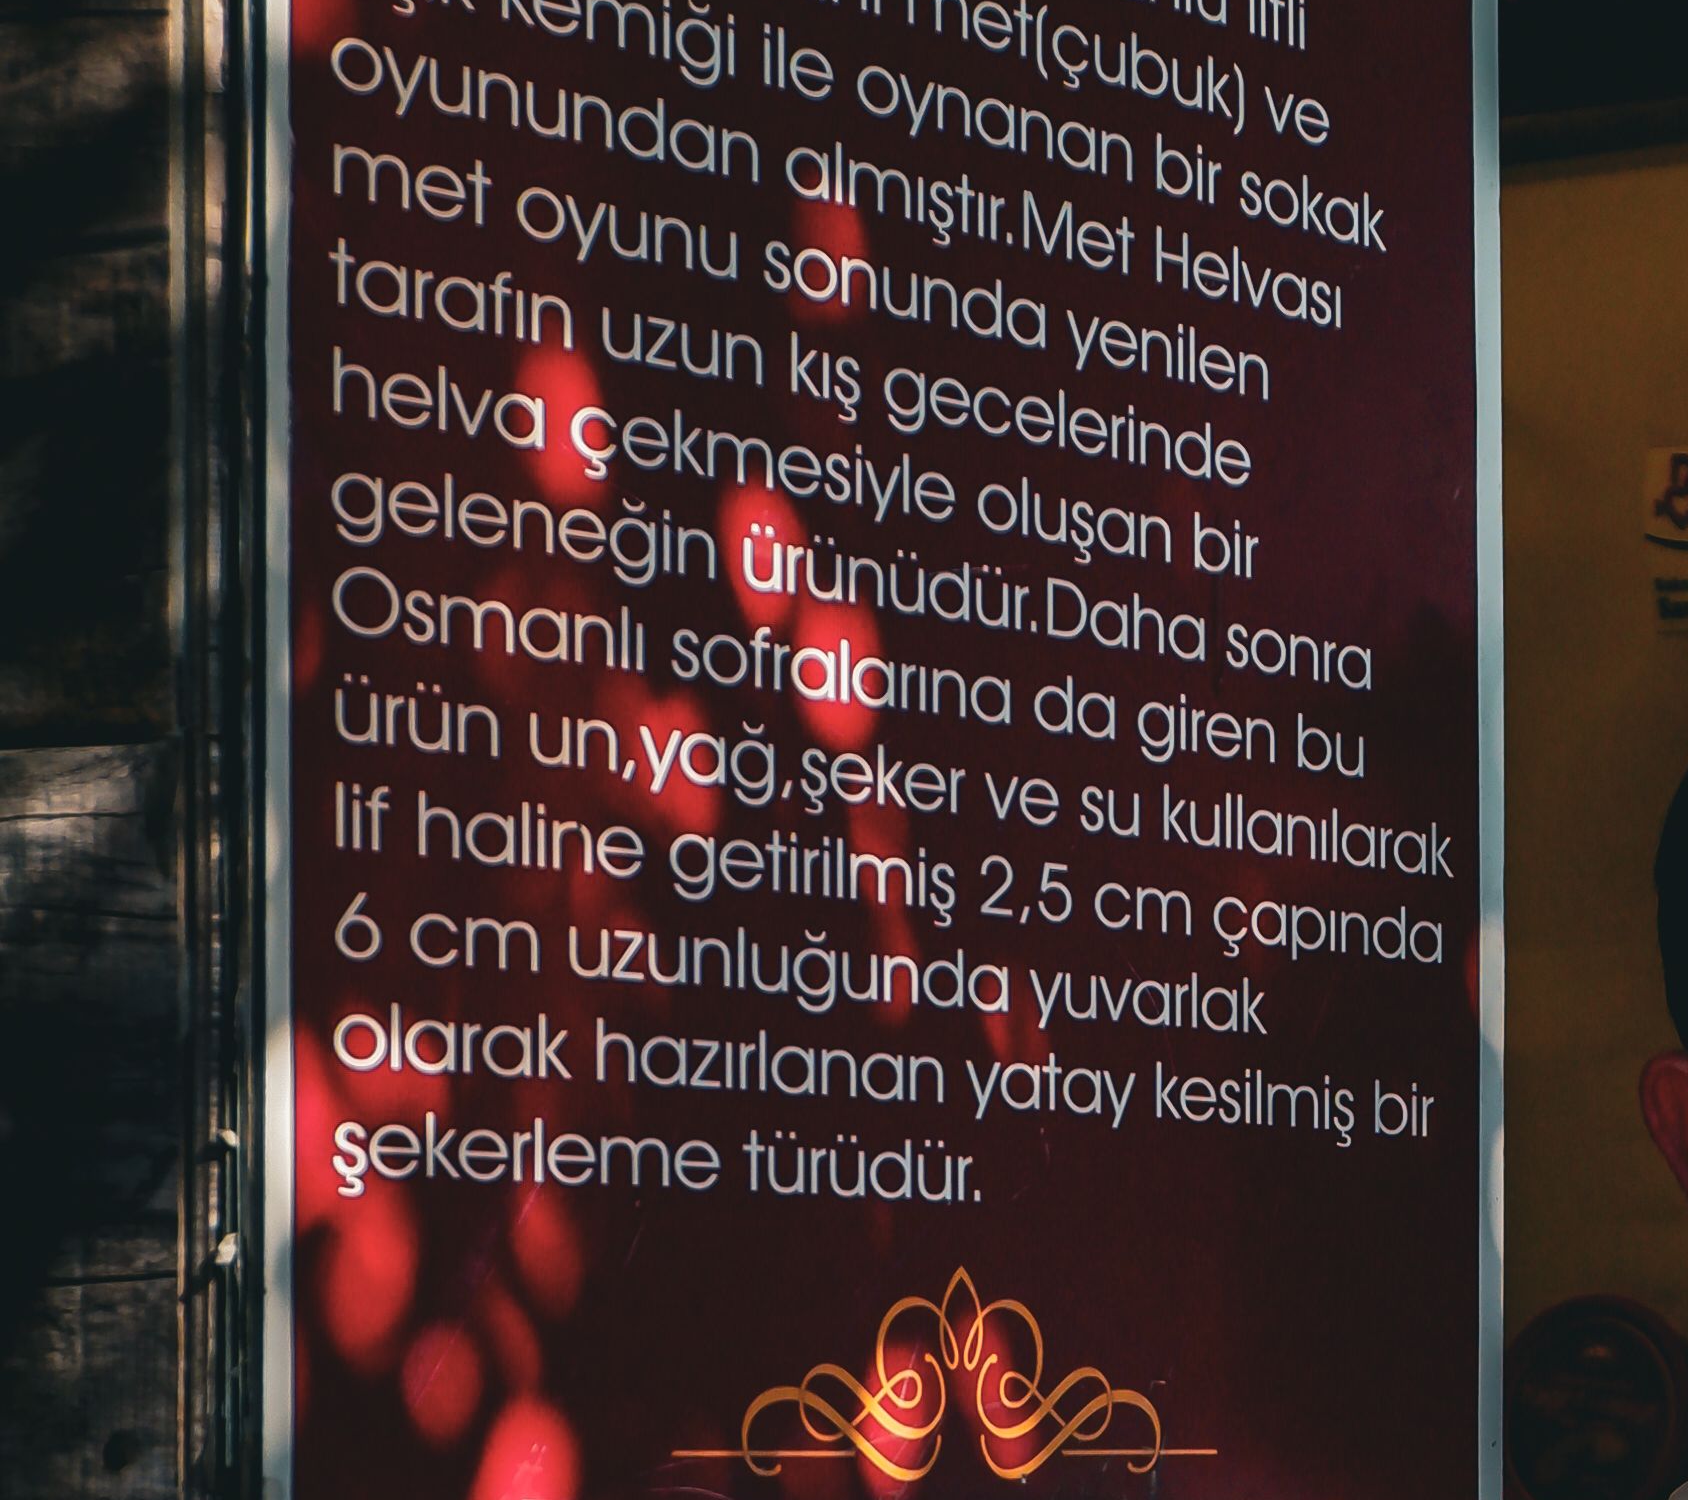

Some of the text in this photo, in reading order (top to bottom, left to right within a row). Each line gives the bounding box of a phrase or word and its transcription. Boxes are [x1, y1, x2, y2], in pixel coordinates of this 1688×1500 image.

[330, 37, 758, 185] oyunundan
[1155, 225, 1346, 330] Helvası
[761, 23, 835, 97] ile
[857, 66, 1133, 185] oynanan
[1152, 126, 1222, 207] bir
[1238, 170, 1388, 253] sokak
[1262, 87, 1331, 145] ve
[330, 142, 1271, 402] met oyunu sonunda yenilen
[330, 239, 1252, 485] tarafın uzun kış gecelerinde
[330, 349, 1260, 578] helva çekmesiyle oluşan bir
[330, 471, 718, 585] geleneğin
[1224, 626, 1373, 690] sonra
[330, 566, 1367, 777] Osmanlı sofralarına da giren bu
[332, 677, 501, 757] ürün
[983, 772, 1057, 825] ve
[1079, 788, 1143, 837] su
[1162, 784, 1452, 879] kullanılarak
[334, 784, 1445, 965] lif haline getirilmiş 2,5 cm çapında
[334, 891, 1266, 1036] 6 cm uzunluğunda yuvarlak
[332, 1010, 1435, 1146] olarak hazırlanan yatay kesilmiş bir
[332, 1112, 985, 1205] şekerleme türüdür.
